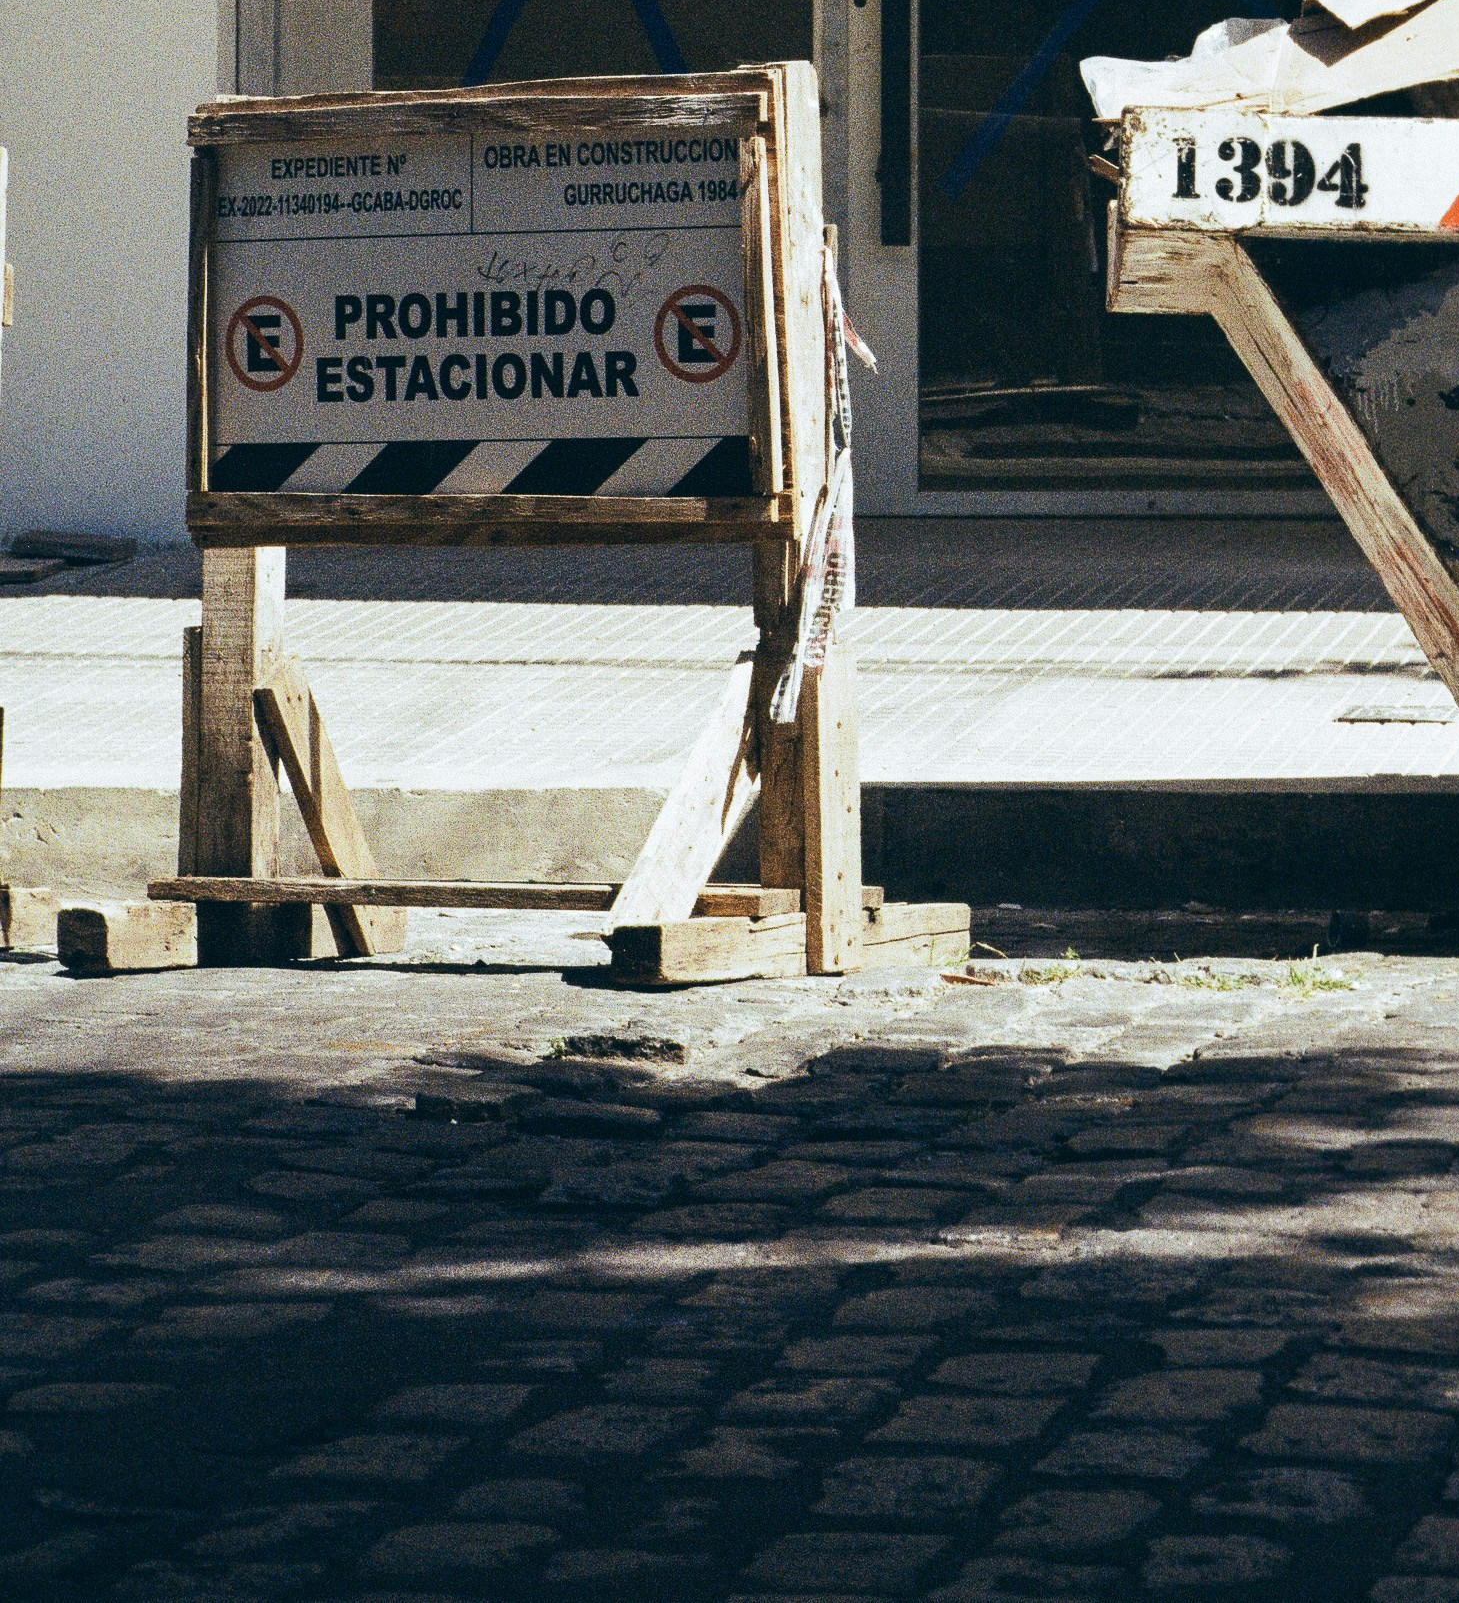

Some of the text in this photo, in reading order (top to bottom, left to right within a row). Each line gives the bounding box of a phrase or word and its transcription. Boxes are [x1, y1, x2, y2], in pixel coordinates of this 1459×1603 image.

[271, 154, 383, 180] EXPEDIENTE
[483, 137, 739, 171] OBRA EN CONSTRUCCION
[1167, 136, 1370, 211] 1394
[563, 178, 739, 207] GURRUCHAGA 1984
[334, 286, 617, 341] PROHIBIDO
[315, 349, 640, 404] ESTACIONAR
